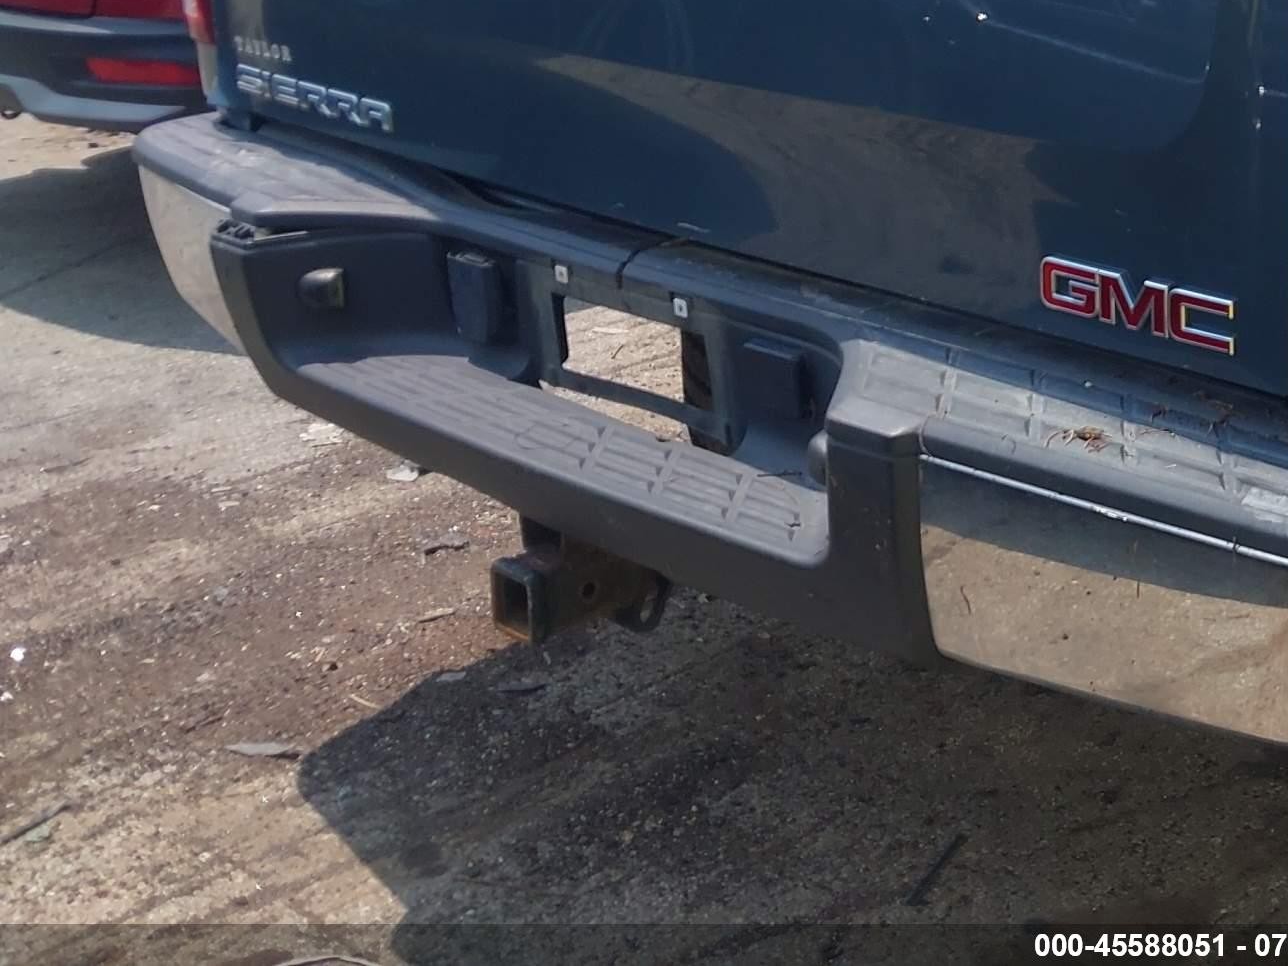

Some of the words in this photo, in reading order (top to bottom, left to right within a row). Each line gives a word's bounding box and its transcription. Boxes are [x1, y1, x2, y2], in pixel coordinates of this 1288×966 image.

[233, 35, 292, 62] TAYLOR
[236, 63, 394, 132] SIERRA
[1040, 255, 1235, 356] GMC
